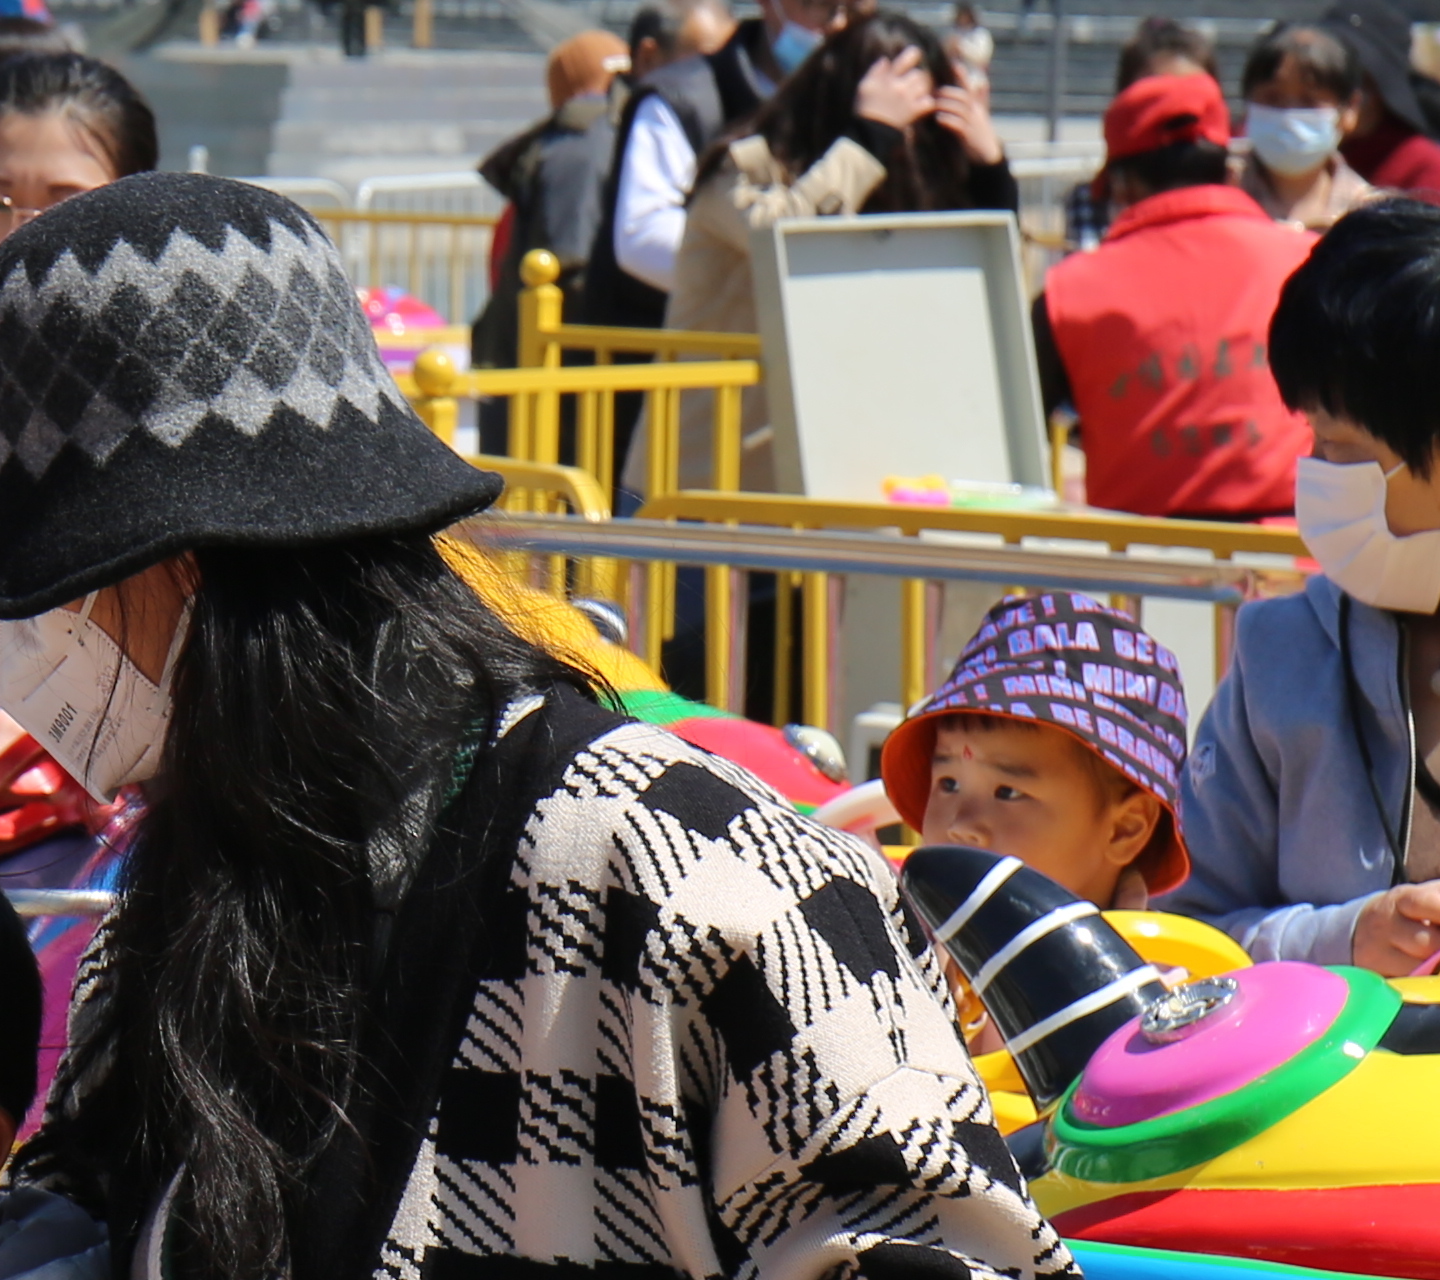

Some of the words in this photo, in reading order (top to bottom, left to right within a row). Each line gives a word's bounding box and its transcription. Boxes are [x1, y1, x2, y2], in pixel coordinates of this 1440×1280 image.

[1008, 621, 1100, 657] BALA
[1113, 628, 1155, 664] BE
[1002, 674, 1086, 702] MINI
[1082, 662, 1157, 706] MINI
[47, 700, 78, 743] 3M9001
[1049, 702, 1094, 734] BE
[1096, 715, 1178, 789] BRAVE
